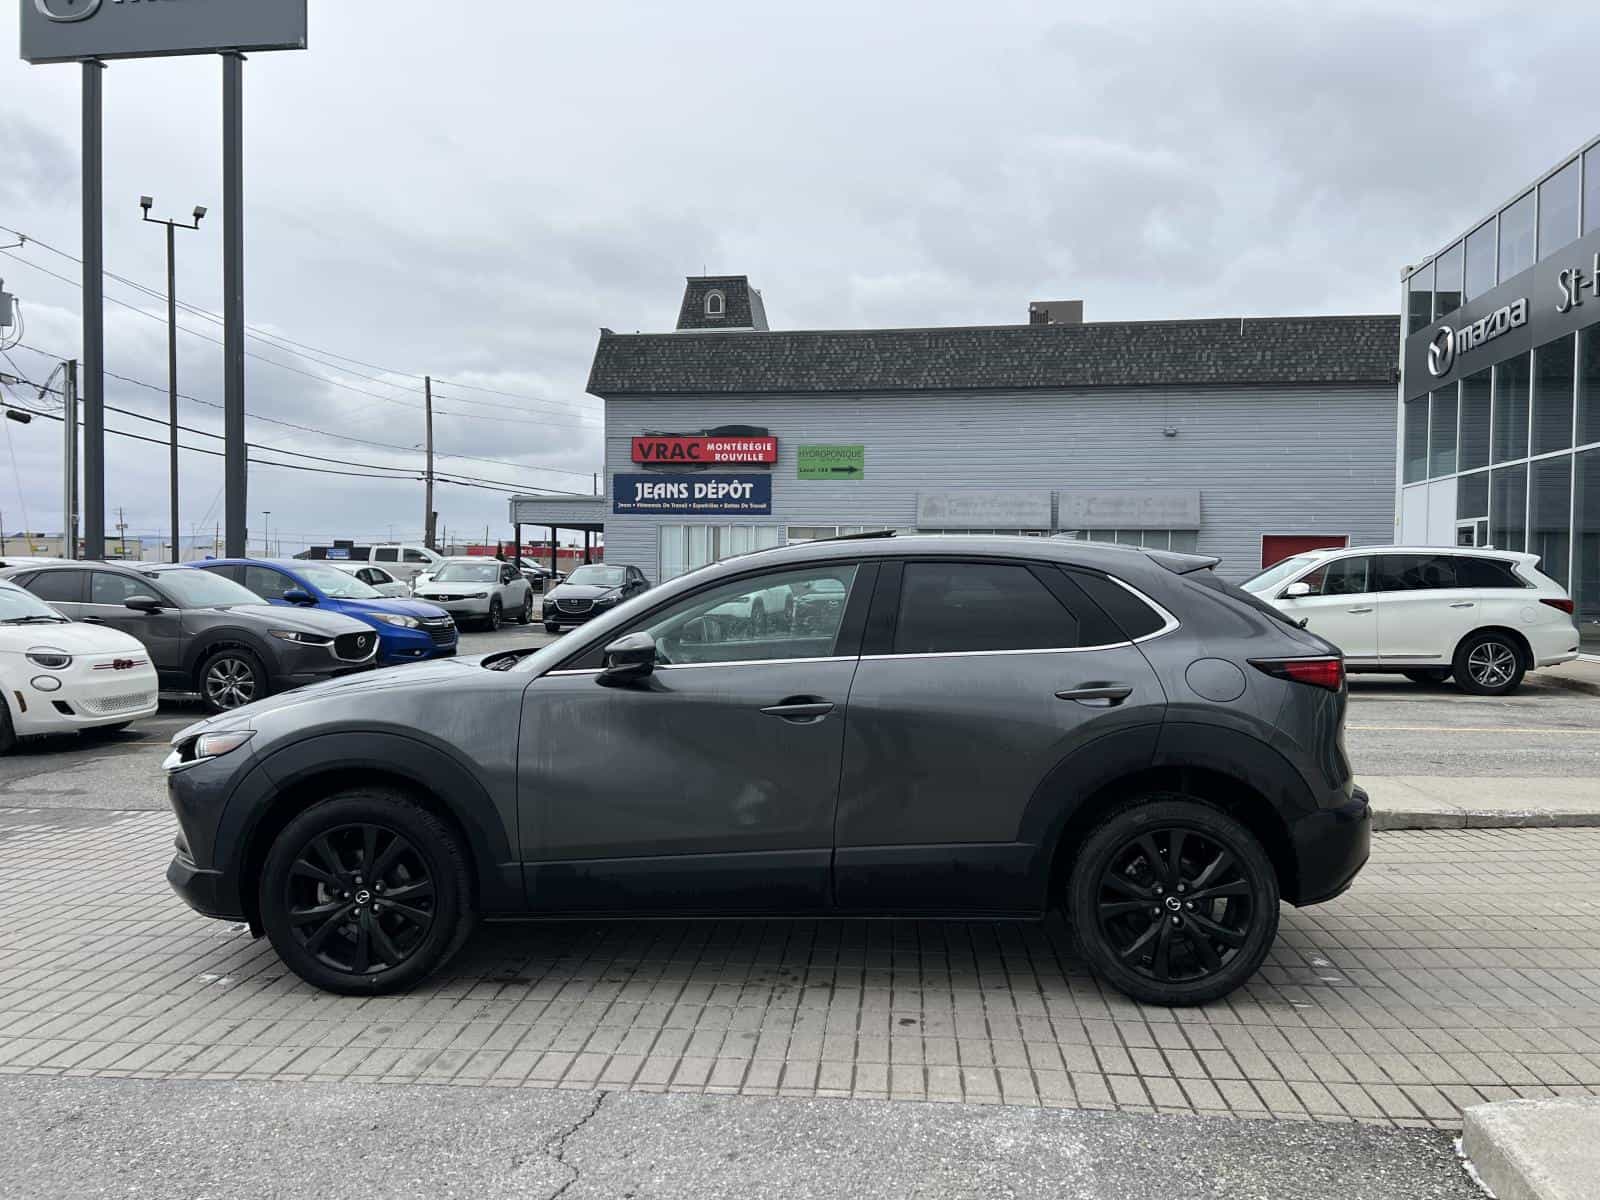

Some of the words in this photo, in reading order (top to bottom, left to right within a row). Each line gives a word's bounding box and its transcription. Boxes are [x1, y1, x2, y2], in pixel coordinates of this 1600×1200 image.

[637, 443, 700, 459] VRAC
[705, 442, 772, 451] MONTÉRÉGIE
[714, 453, 764, 461] ROUVILLE
[635, 482, 688, 501] JEANS
[694, 479, 753, 499] DÉPÔT
